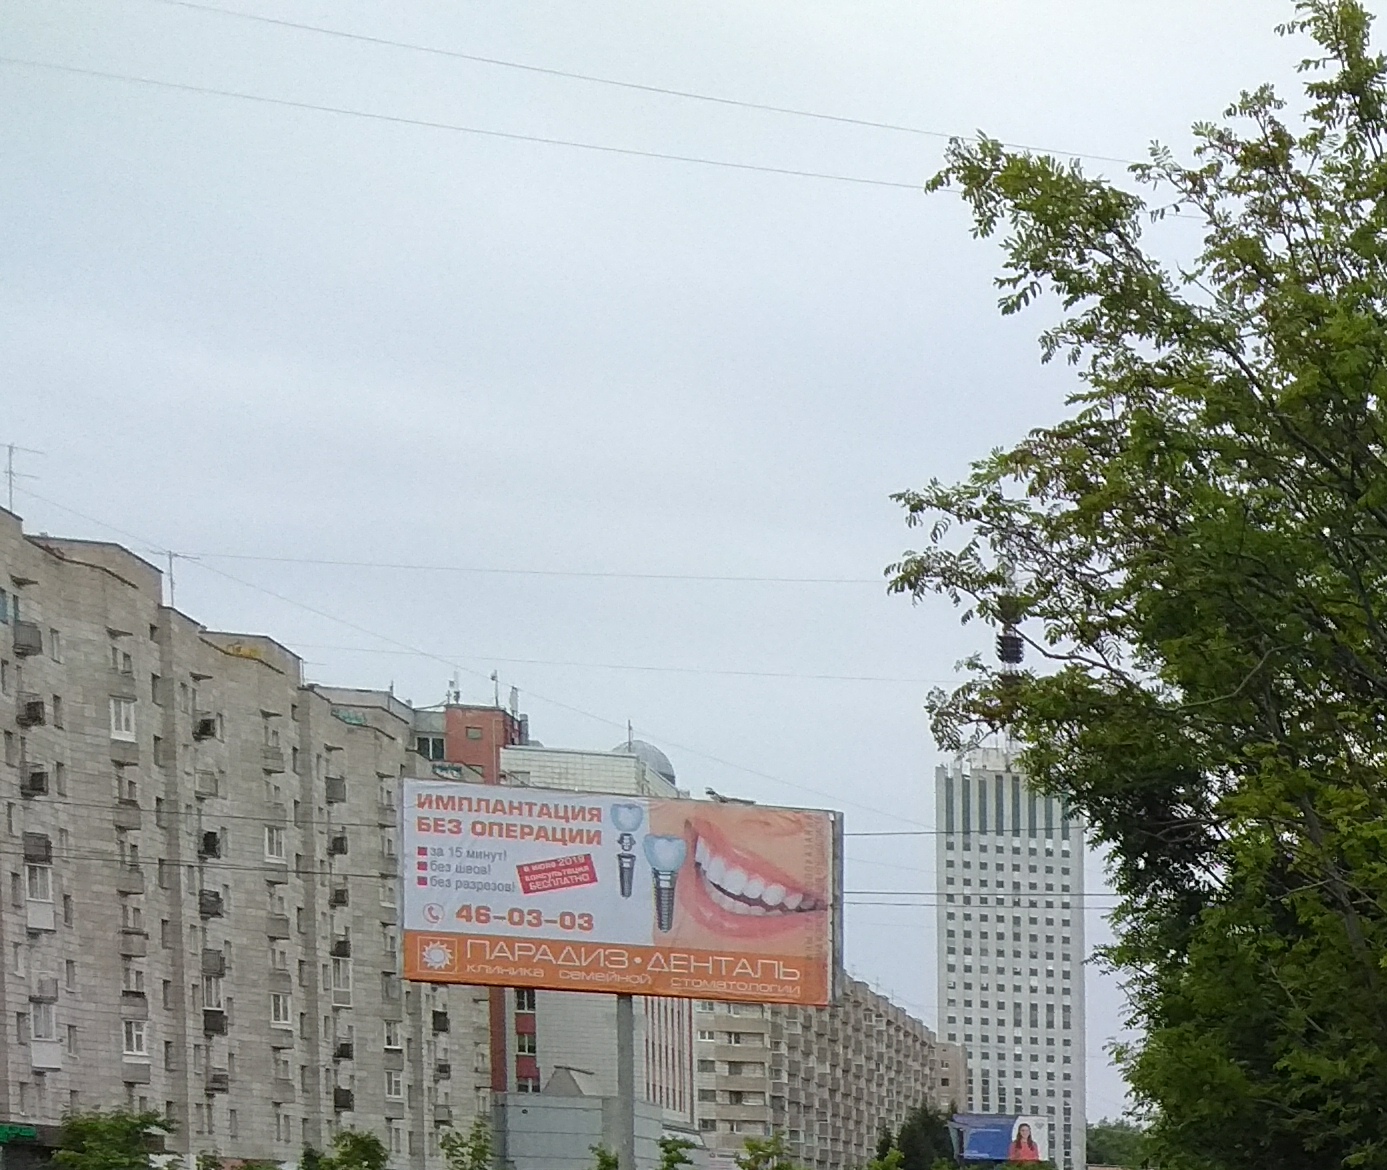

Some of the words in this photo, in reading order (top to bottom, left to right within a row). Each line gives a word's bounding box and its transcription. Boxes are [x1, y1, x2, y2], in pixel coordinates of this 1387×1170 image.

[417, 793, 602, 823] ИМПЛАНТАЦИЯ
[417, 816, 462, 835] БЕЗ
[471, 820, 602, 846] ОПЕРАЦИИ
[430, 847, 444, 857] за
[450, 847, 462, 858] 15
[466, 850, 507, 862] минут!
[430, 861, 450, 872] без
[455, 864, 491, 875] швов!
[430, 875, 450, 888] без
[455, 879, 515, 893] разрезов!
[455, 903, 594, 931] 46-03-03
[466, 939, 628, 969] ПАРАДИЗ
[647, 951, 800, 981] ДЕНТАЛЬ
